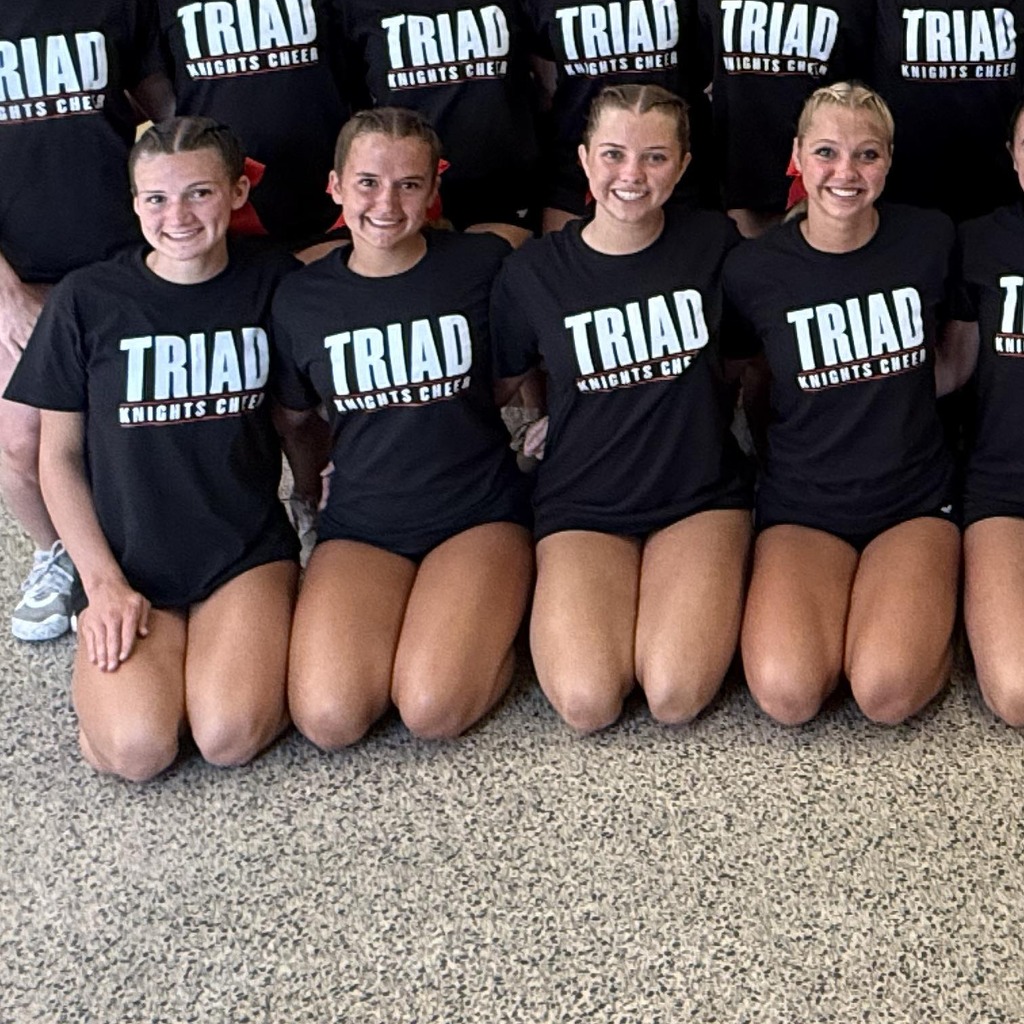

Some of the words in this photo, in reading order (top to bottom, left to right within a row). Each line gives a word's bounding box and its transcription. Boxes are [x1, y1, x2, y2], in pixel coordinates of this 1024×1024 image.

[381, 5, 510, 69] TRIAD
[720, 0, 839, 61] TRIAD
[902, 8, 1017, 62] TRIAD
[0, 31, 108, 102] RIAD
[186, 56, 260, 78] KNIGHTS
[268, 47, 318, 68] CHEER
[388, 66, 458, 88] KNIGHTS
[564, 57, 628, 76] KNIGHTS
[635, 51, 678, 70] CHEER
[901, 64, 967, 79] KNIGHTS
[0, 100, 47, 121] GHTS
[564, 289, 709, 375] TRIAD
[787, 286, 925, 371] TRIAD
[120, 327, 270, 402] TRIAD
[324, 313, 473, 396] TRIAD
[577, 365, 652, 392] KNIGHTS
[661, 355, 693, 376] CHE
[797, 365, 872, 390] KNIGHTS
[119, 401, 206, 424] KNIGHTS
[334, 388, 412, 413] KNIGHTS
[420, 376, 471, 402] CHEER
